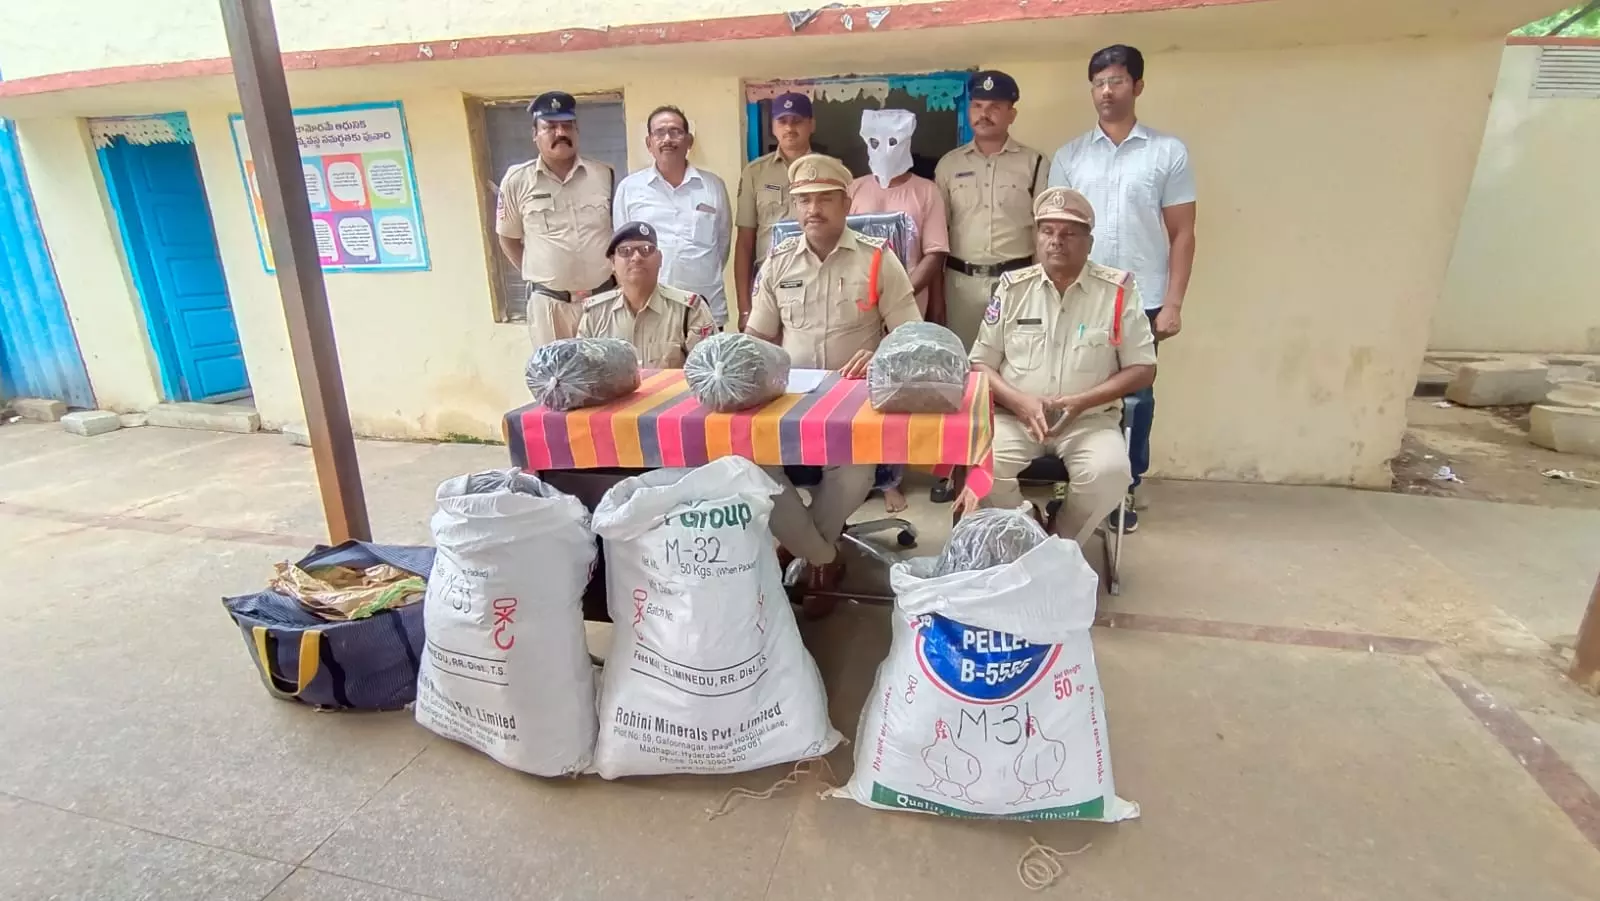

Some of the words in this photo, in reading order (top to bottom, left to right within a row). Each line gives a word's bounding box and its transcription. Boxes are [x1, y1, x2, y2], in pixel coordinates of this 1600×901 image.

[680, 502, 752, 530] Group
[665, 536, 728, 564] M-32
[680, 563, 691, 575] 50
[693, 564, 714, 579] Kgs.
[647, 602, 665, 617] Batch
[962, 629, 1030, 654] PELLE
[633, 650, 648, 664] Feed
[664, 665, 718, 688] ELIMINEDU,
[720, 673, 738, 685] RR.
[961, 657, 1032, 686] B-5555
[1054, 677, 1073, 701] 50
[476, 708, 517, 730] Limited
[616, 707, 652, 731] Rohini
[655, 716, 709, 742] Minerals
[712, 727, 736, 742] Pvt.
[739, 701, 782, 733] Limited
[957, 701, 1030, 745] M-31
[734, 725, 766, 745] Hospital
[681, 750, 727, 759] Hyderabad
[732, 744, 747, 755] 500
